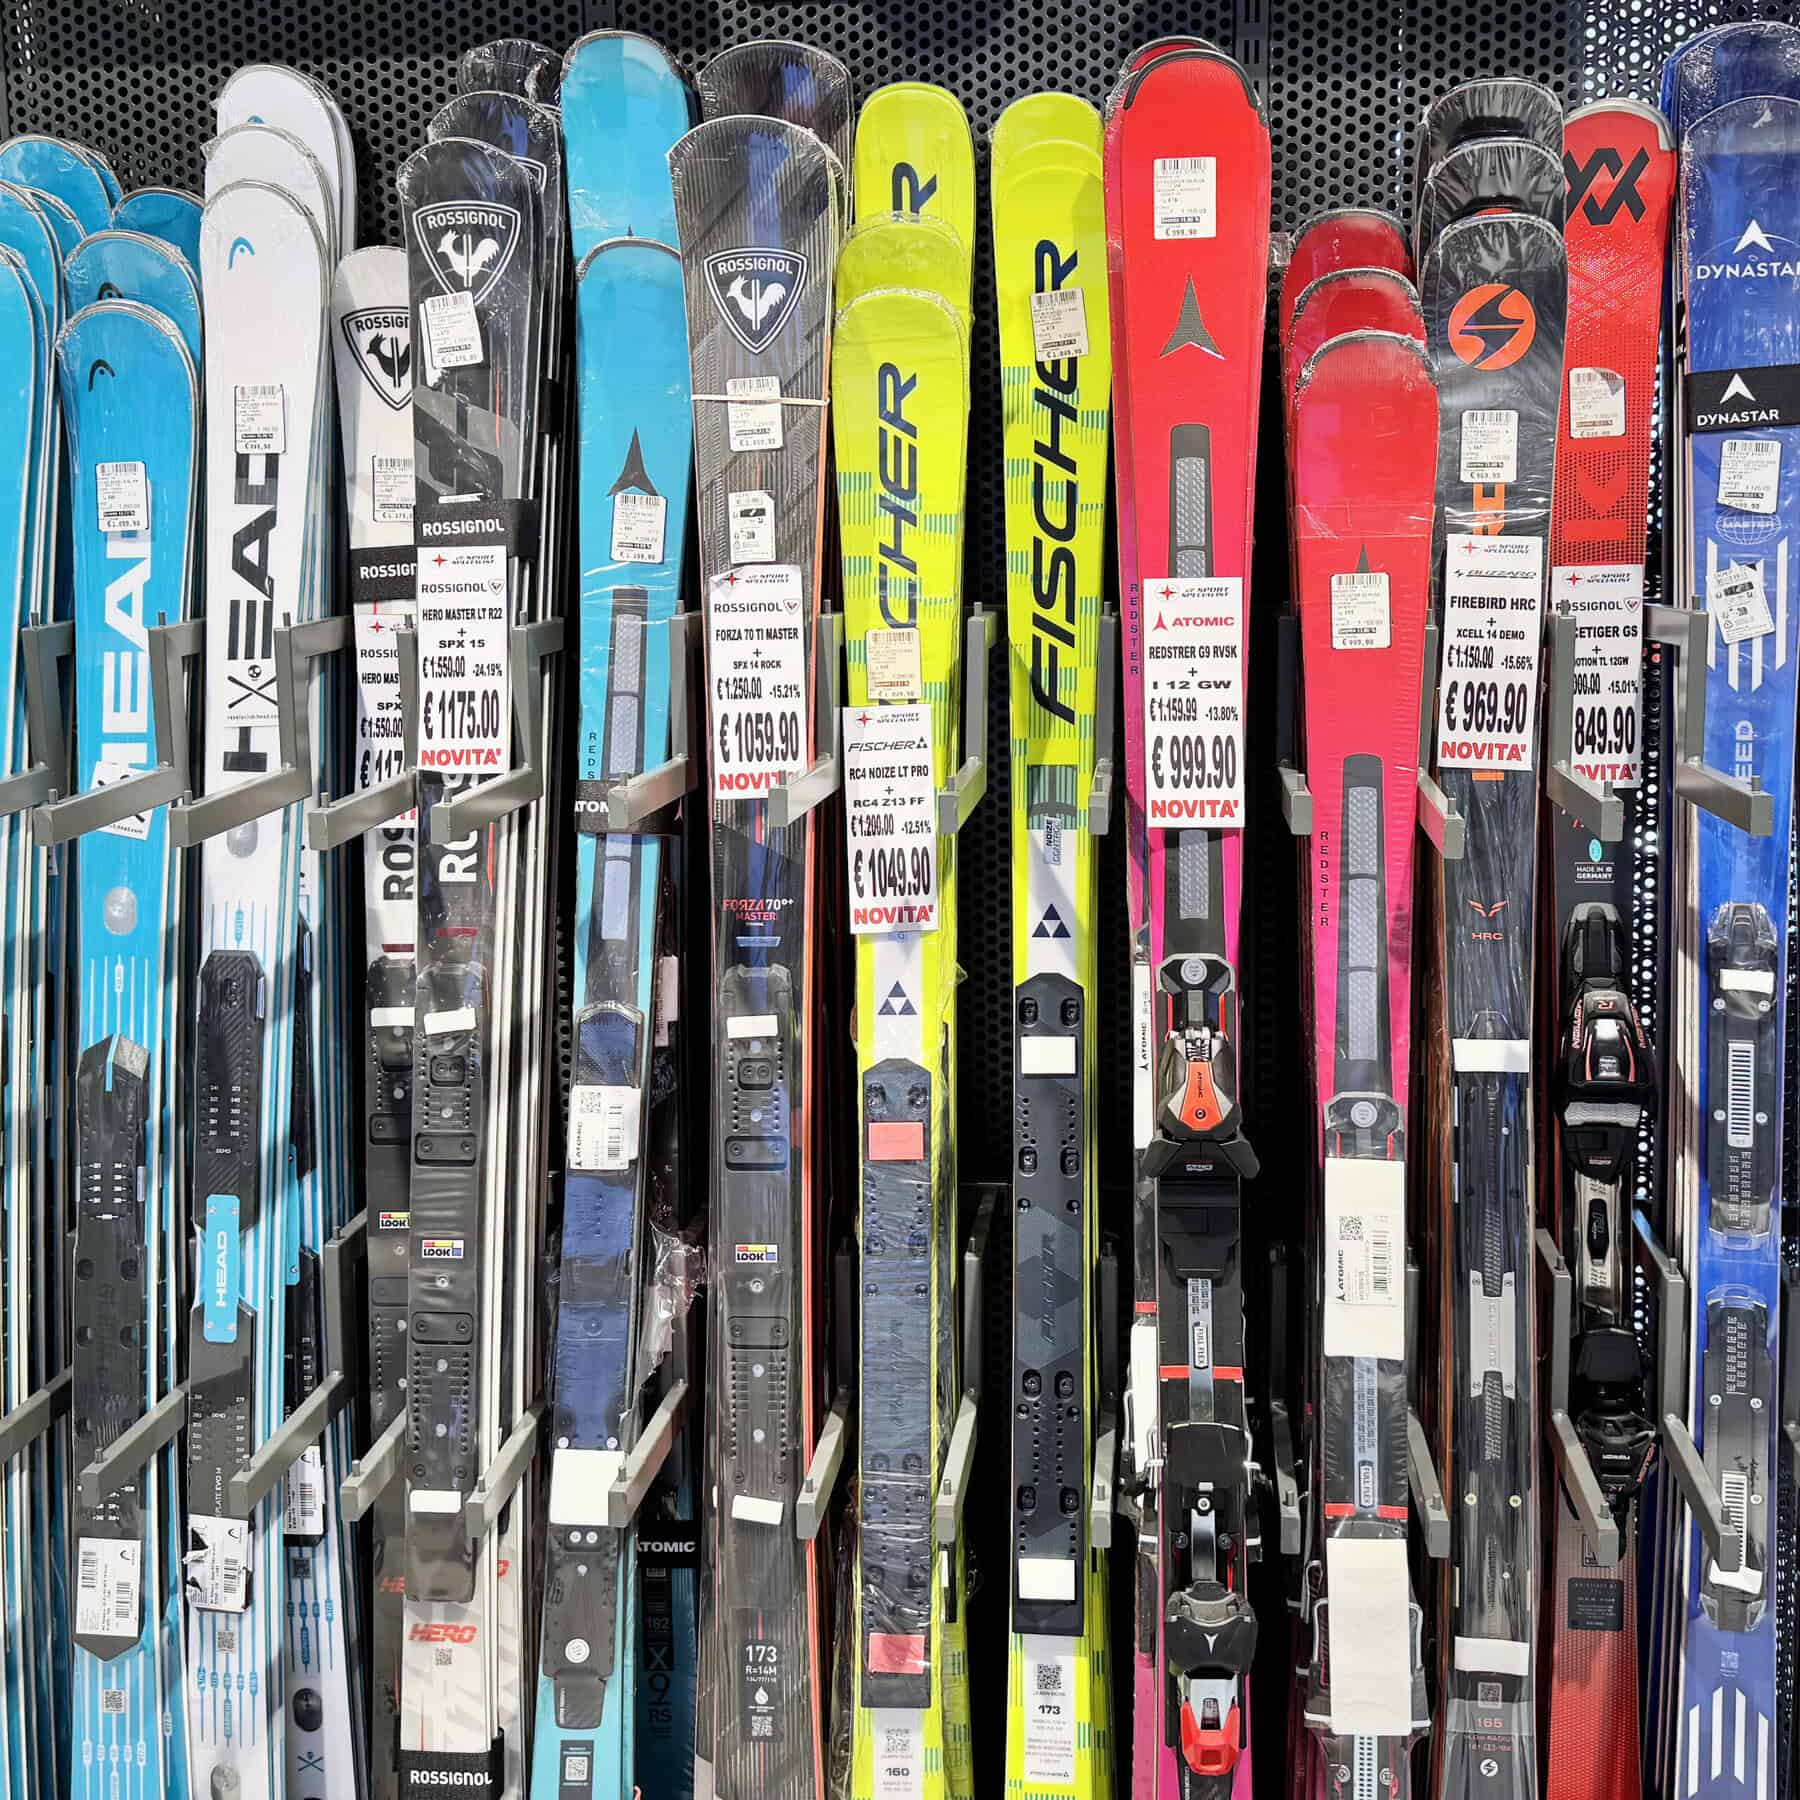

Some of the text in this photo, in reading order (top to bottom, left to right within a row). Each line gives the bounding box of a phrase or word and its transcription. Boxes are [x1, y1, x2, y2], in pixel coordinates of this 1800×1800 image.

[426, 210, 507, 230] ROSSIGNOL
[716, 257, 793, 276] ROSSIGNOL
[1697, 409, 1780, 426] DYNASTAR
[878, 362, 917, 628] CHER
[422, 519, 505, 537] ROSSIGNOL
[421, 583, 488, 593] ROSSIGNOL
[714, 602, 783, 613] ROSSIGNOL
[1450, 596, 1536, 611] FIREBIRD HRC
[1556, 601, 1623, 611] RSSIGNOL
[422, 607, 503, 621] HERO MASTER LT R22
[1130, 583, 1139, 675] REDSTER
[1172, 617, 1235, 627] ATOMIC
[715, 627, 799, 641] FORZA 70 TI MASTER
[1456, 628, 1525, 640] XCELL 14 DEMO
[1622, 625, 1638, 637] GS
[438, 639, 485, 648] SPX 15
[1149, 645, 1237, 659] REDSTRER G9 RVSK
[732, 660, 782, 670] SPX 14 ROCK
[1501, 655, 1533, 670] -15.66%
[1575, 656, 1629, 667] OTION TL 12GW
[472, 663, 503, 677] -24.19%
[361, 673, 400, 685] HERO MAS
[1166, 680, 1191, 690] 12
[1197, 680, 1232, 689] GW
[769, 684, 801, 699] -15.21%
[376, 702, 402, 711] SPX
[1205, 706, 1239, 721] -13.80%
[1446, 680, 1528, 734] € 969.90
[424, 689, 500, 740] € 1175.00
[719, 711, 799, 763] € 1059.90
[1574, 705, 1635, 755] 849.90
[848, 740, 916, 752] FISCHER
[1441, 741, 1527, 761] NOVITA'
[421, 748, 502, 767] NOVITA'
[587, 732, 597, 779] REDS
[1151, 735, 1236, 789] € 999.90
[849, 765, 929, 780] RC4 NOIZE LT PRO
[853, 797, 925, 808] RC4 Z13 FF
[1151, 799, 1239, 818] NOVITA'
[901, 820, 931, 834] -12.51%
[854, 846, 931, 898] € 1049.90
[1320, 831, 1329, 926] REDSTER
[722, 898, 765, 912] FORZA
[736, 912, 777, 921] MASTER
[854, 904, 934, 926] NOVITA'
[1471, 932, 1504, 941] HRC
[381, 1219, 406, 1227] LOOK
[423, 1248, 451, 1257] LOOK
[737, 1253, 764, 1261] LOOK
[215, 1231, 228, 1308] HEAD
[379, 1576, 405, 1593] HE
[408, 1623, 478, 1644] HERO
[746, 1645, 777, 1663] 173
[745, 1665, 777, 1676] R=14M
[1038, 1705, 1061, 1715] 173
[410, 1770, 493, 1786] ROSSIGNOL
